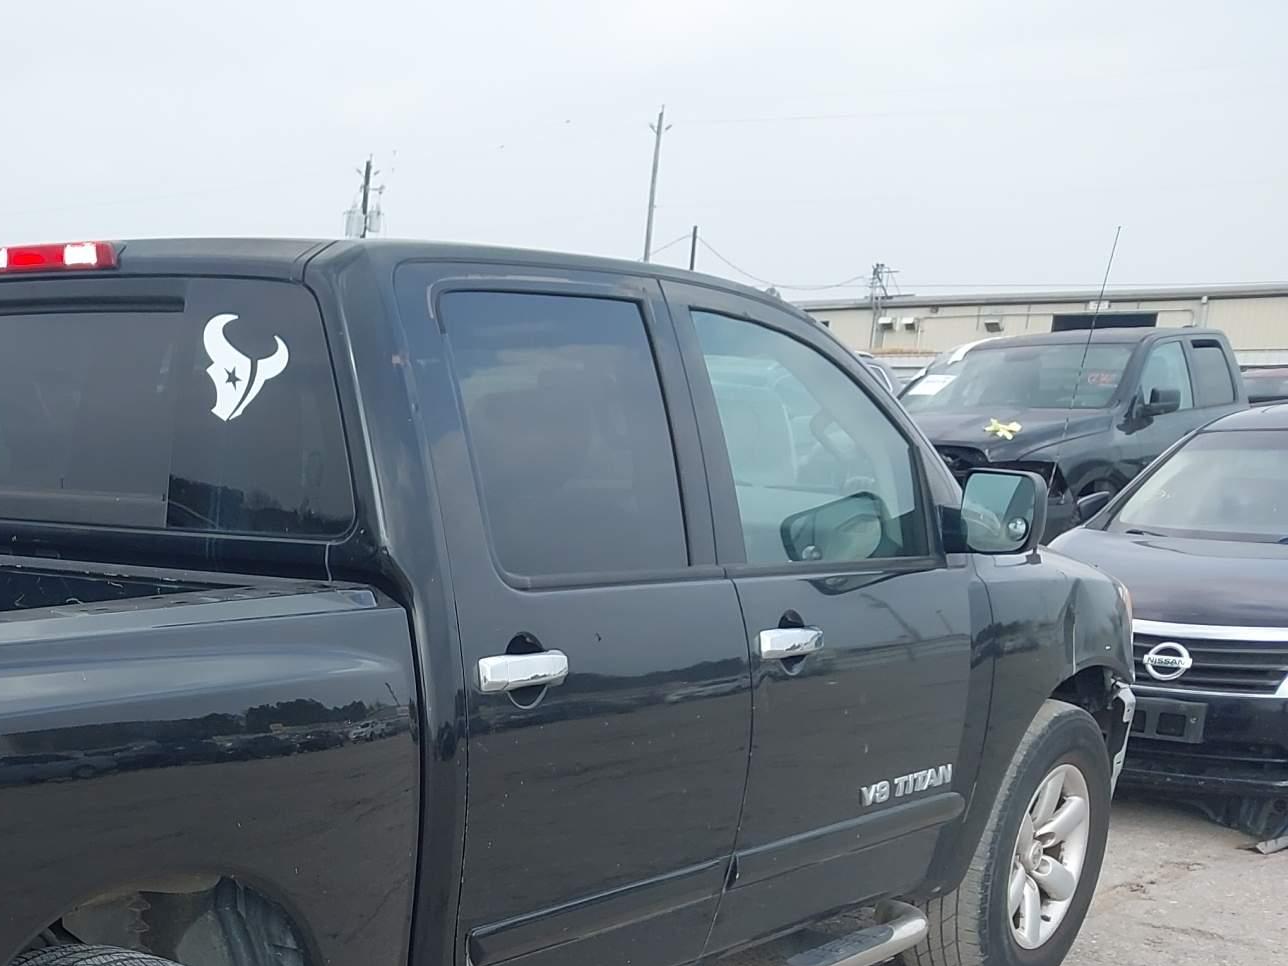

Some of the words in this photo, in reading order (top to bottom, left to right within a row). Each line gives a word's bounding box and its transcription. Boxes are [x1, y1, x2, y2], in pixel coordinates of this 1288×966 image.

[1147, 656, 1185, 666] NISSAN
[860, 780, 890, 807] V8
[894, 763, 953, 797] TITAN
